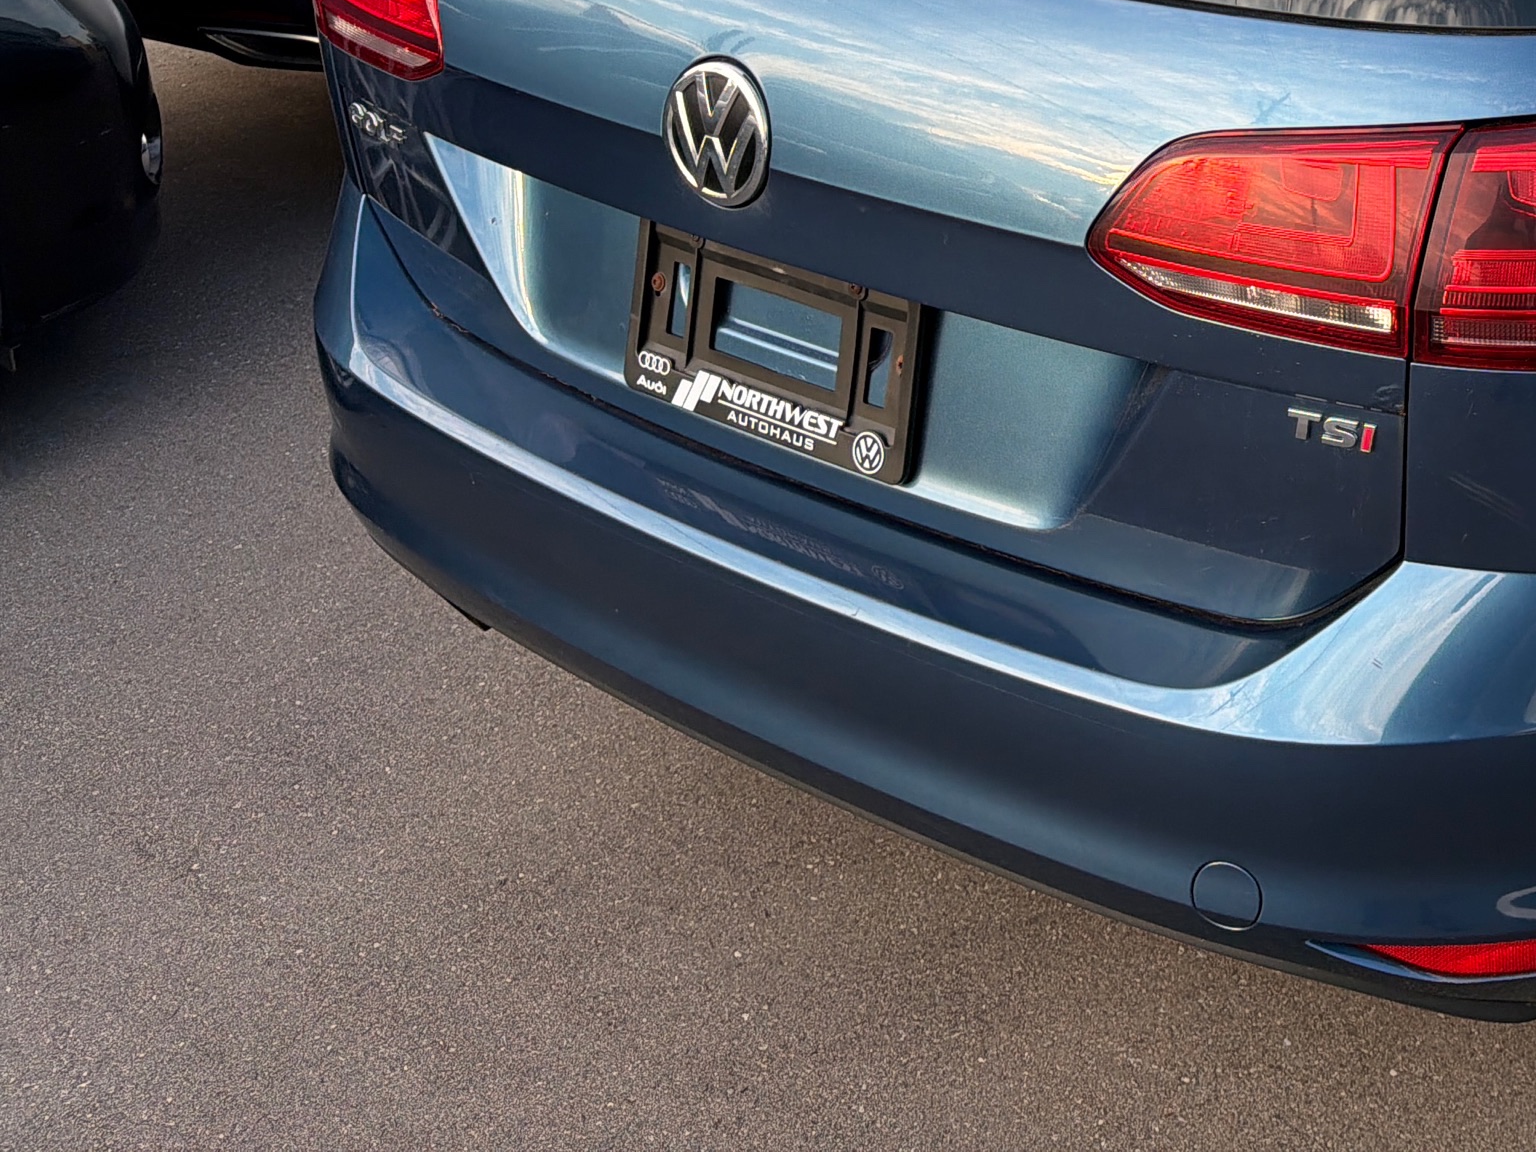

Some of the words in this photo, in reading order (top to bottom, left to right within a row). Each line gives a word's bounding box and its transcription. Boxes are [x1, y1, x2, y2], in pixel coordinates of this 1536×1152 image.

[636, 374, 668, 396] Audi
[717, 383, 844, 439] NORTHWEST
[727, 410, 816, 452] AUTOHAUS
[1287, 407, 1377, 454] TSI
